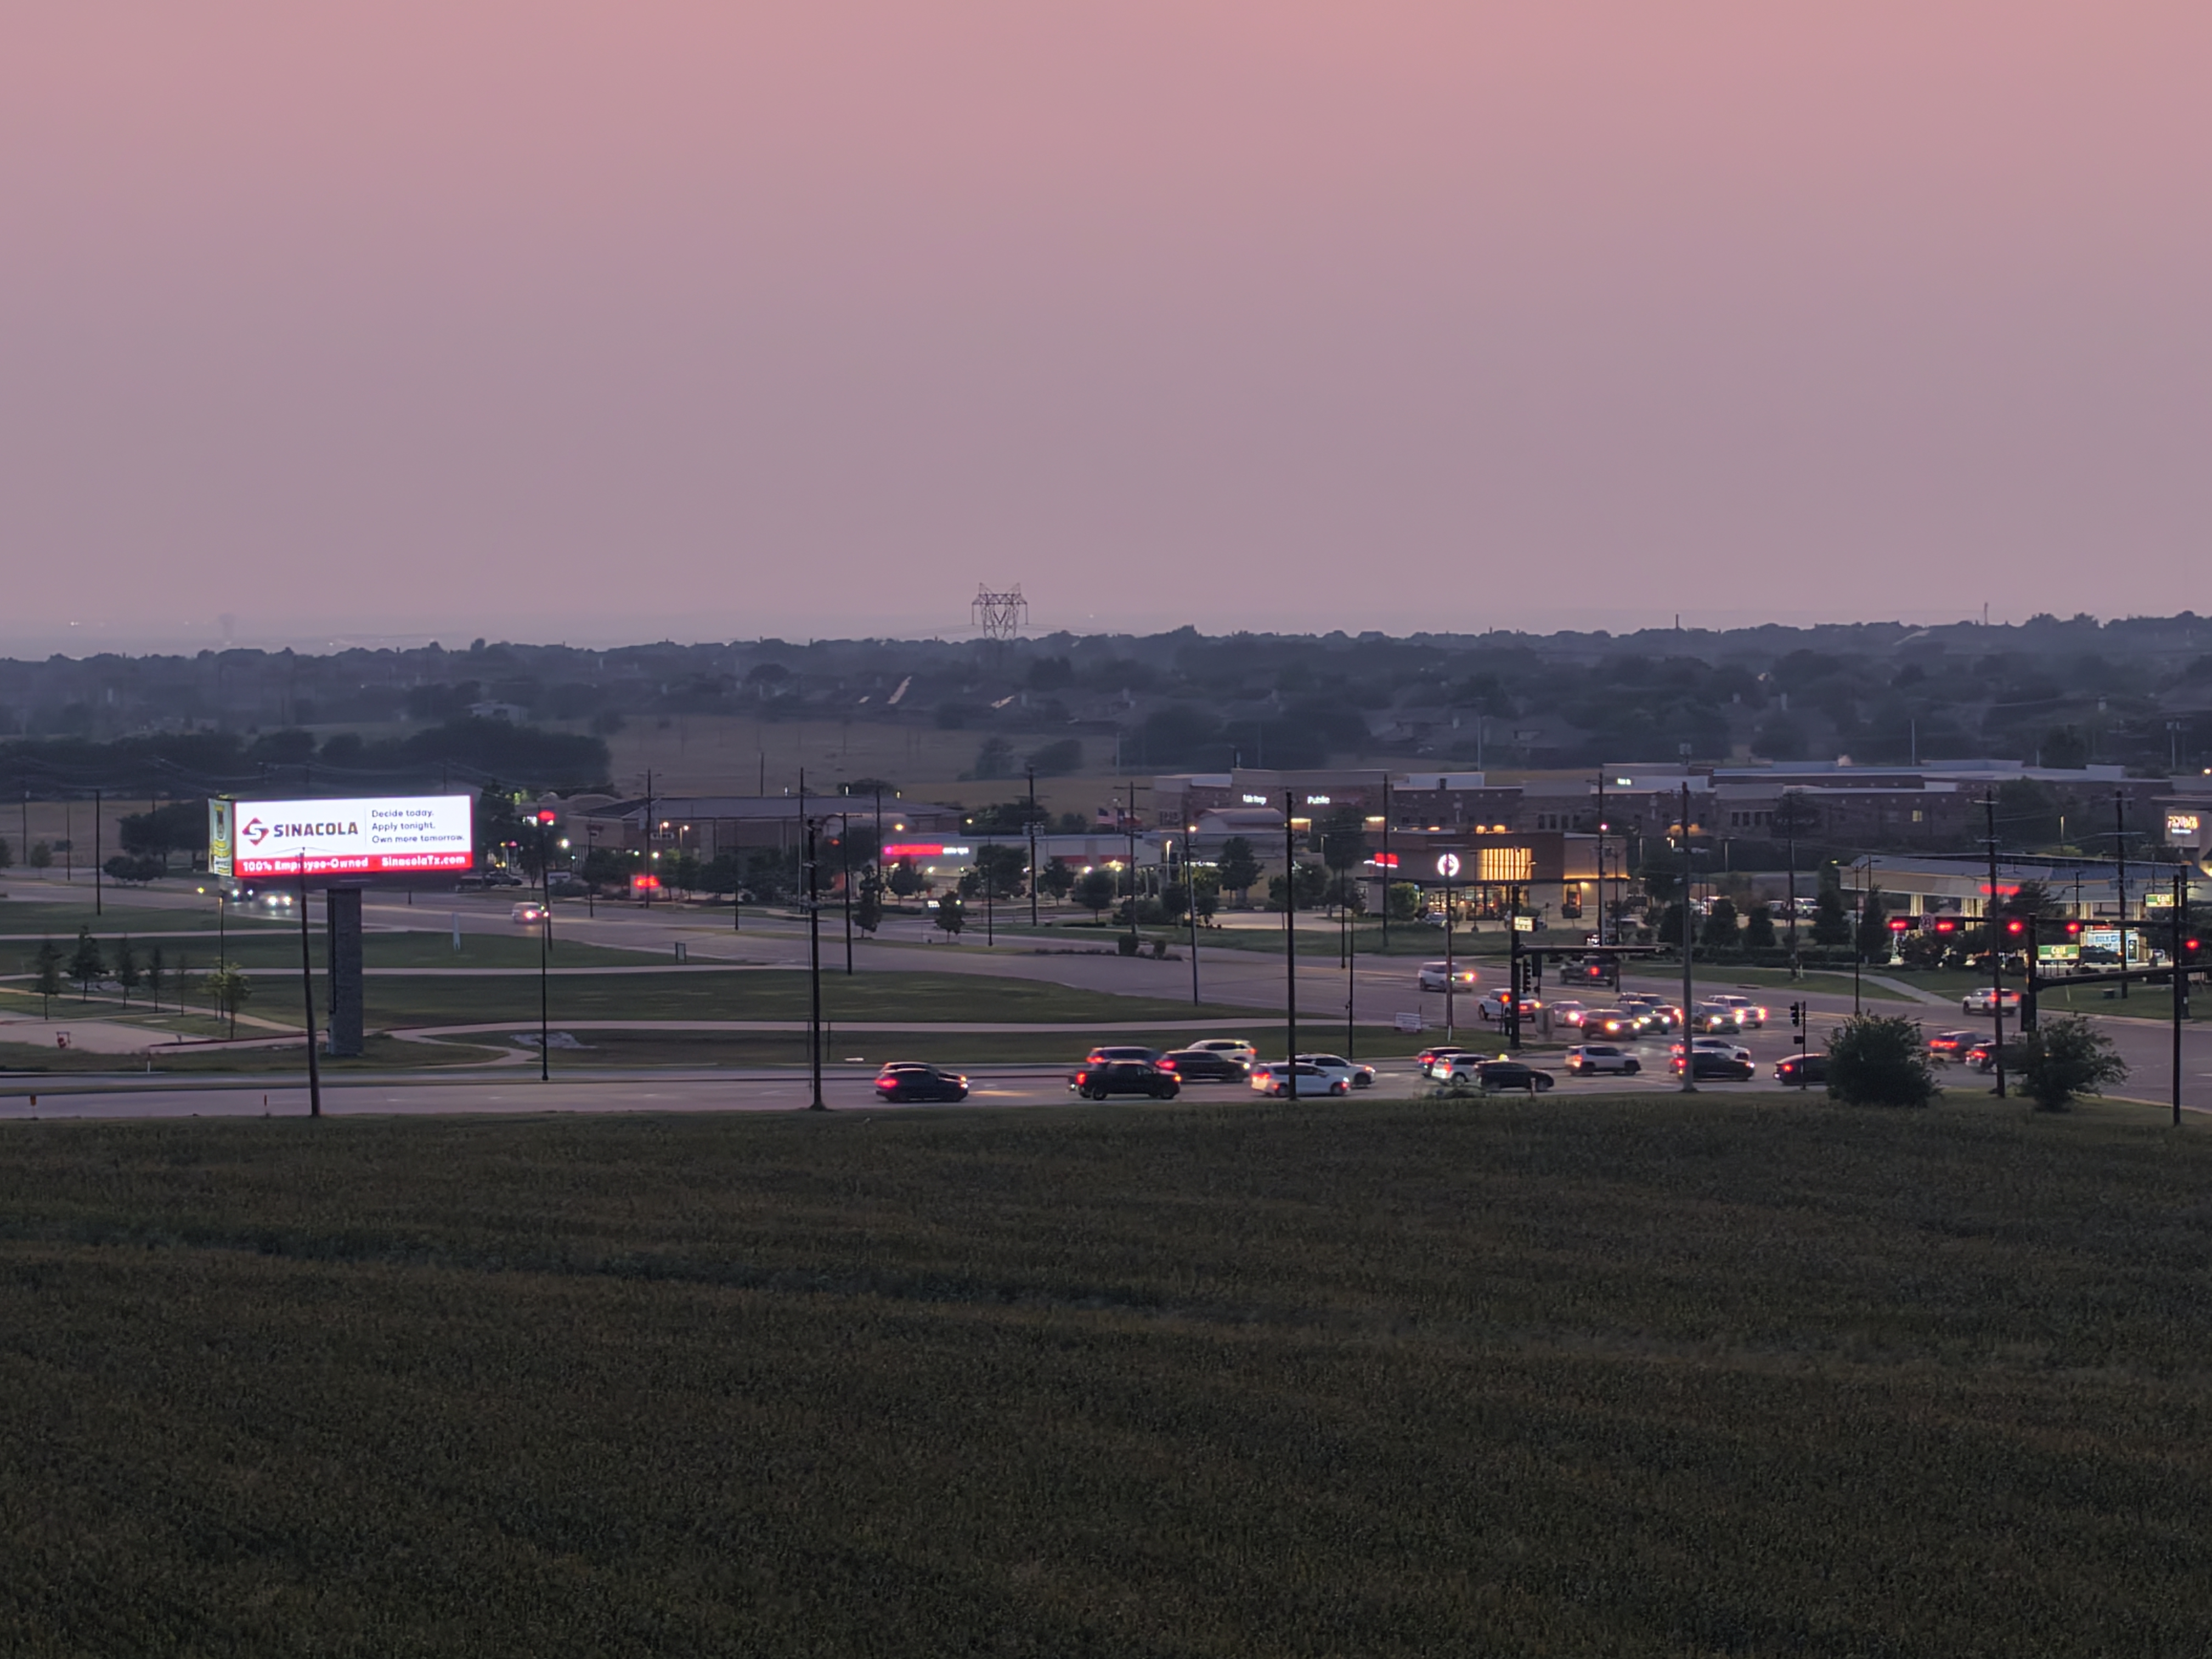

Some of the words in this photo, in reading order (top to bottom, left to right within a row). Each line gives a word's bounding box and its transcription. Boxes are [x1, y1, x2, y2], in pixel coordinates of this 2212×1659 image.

[372, 809, 403, 818] Decide
[406, 809, 434, 818] today.
[274, 822, 358, 838] SINACOLA
[372, 822, 398, 832] Apply
[400, 822, 436, 831] tonight.
[372, 835, 393, 844] Own
[382, 855, 465, 867] SinacolaTx.com
[243, 861, 273, 872] 100%
